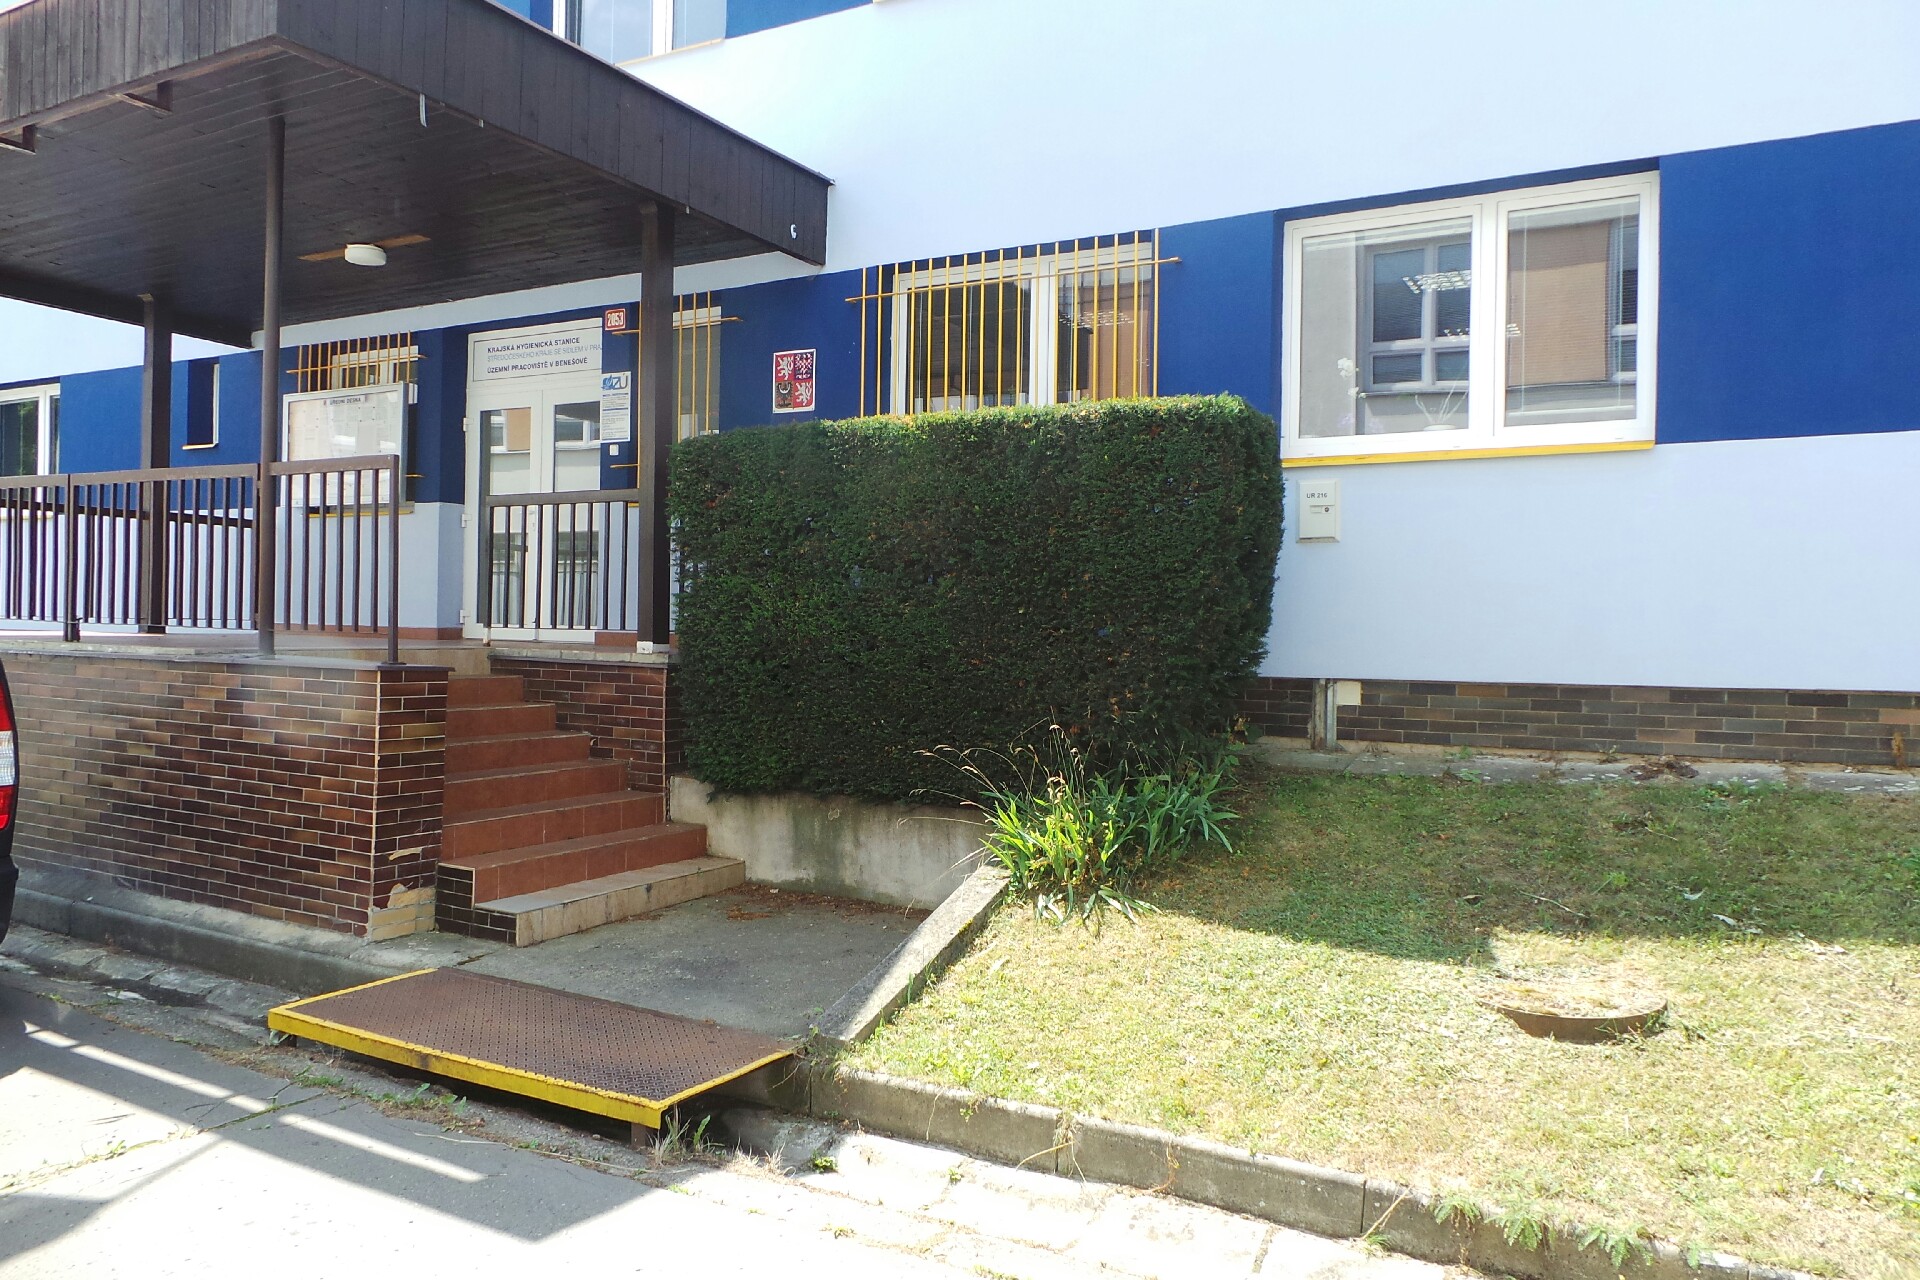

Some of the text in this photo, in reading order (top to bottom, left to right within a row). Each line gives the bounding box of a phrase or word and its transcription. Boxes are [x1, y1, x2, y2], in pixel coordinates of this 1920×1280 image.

[607, 312, 624, 326] 2053
[554, 337, 580, 346] STANICE
[590, 343, 602, 351] PRA
[487, 364, 510, 373] ÚZEMNÍ
[511, 361, 549, 371] PRACOVIŠTĚ
